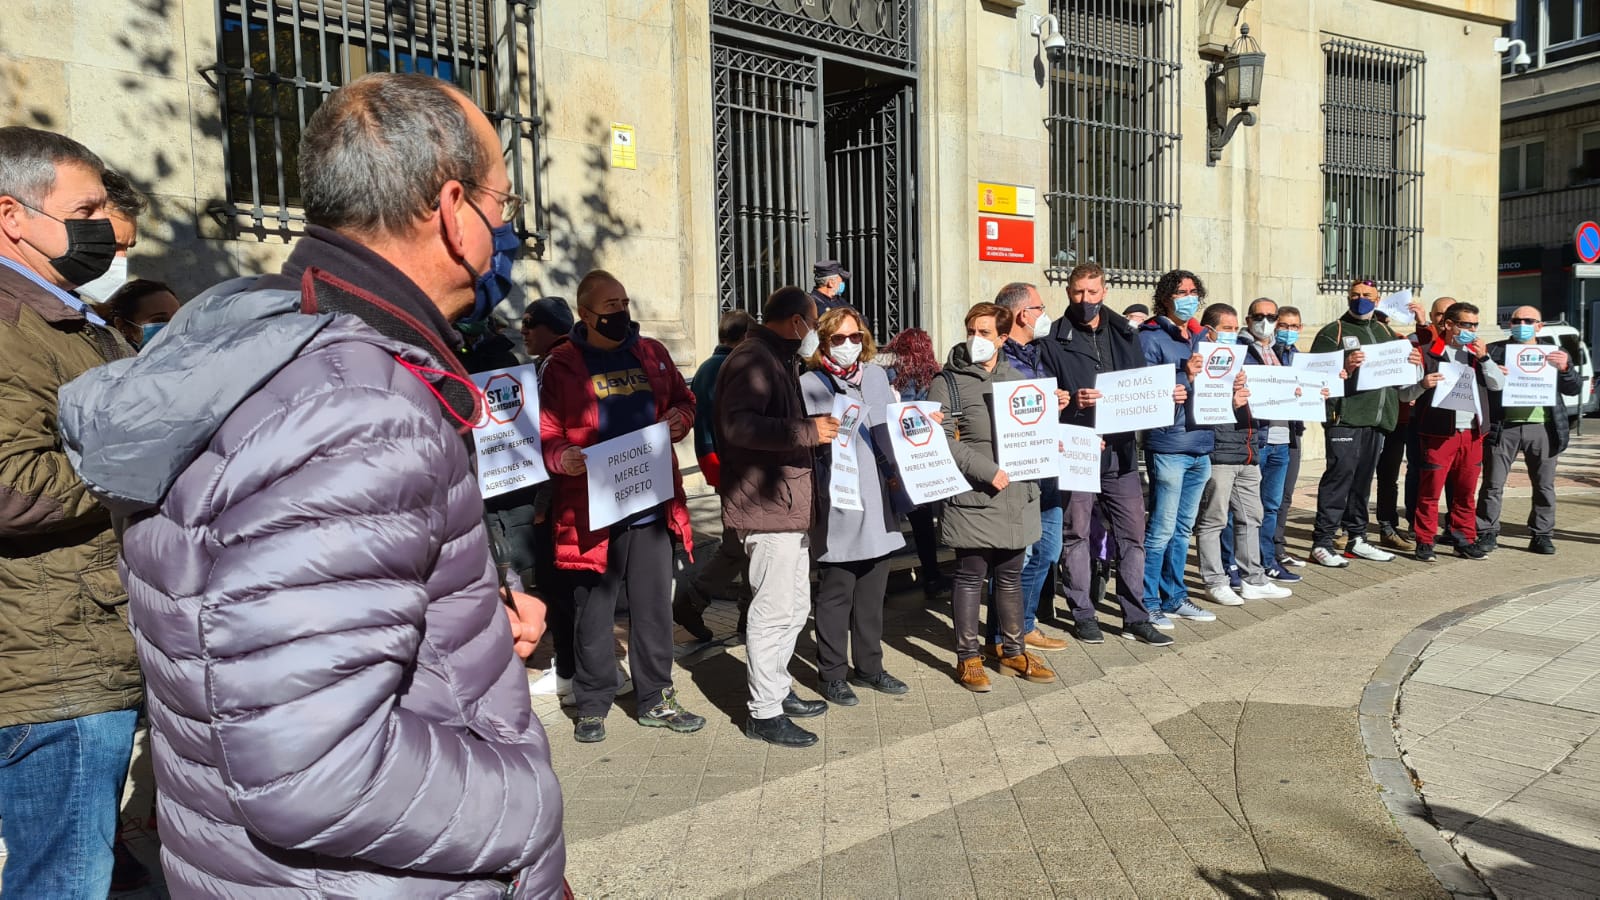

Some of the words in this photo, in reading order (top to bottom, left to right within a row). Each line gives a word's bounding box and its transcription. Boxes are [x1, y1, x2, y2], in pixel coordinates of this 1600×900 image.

[1117, 379, 1131, 388] NO
[1102, 391, 1156, 404] AGRESIONES
[1157, 389, 1169, 399] EN
[489, 399, 521, 413] AGRESIONES
[1014, 406, 1043, 415] AGRESIONES
[1115, 404, 1158, 416] PRISIONES
[480, 429, 515, 444] #PRISIONES
[1004, 441, 1028, 449] MERECE
[1029, 438, 1054, 446] RESPETO
[481, 443, 505, 456] MERECE
[508, 436, 535, 449] RESPETO
[608, 442, 653, 468] PRISIONES
[483, 463, 520, 478] #PRISIONES
[522, 459, 533, 469] SIN
[614, 462, 650, 484] MERECE
[485, 474, 527, 491] AGRESIONES
[614, 479, 653, 503] RESPETO
